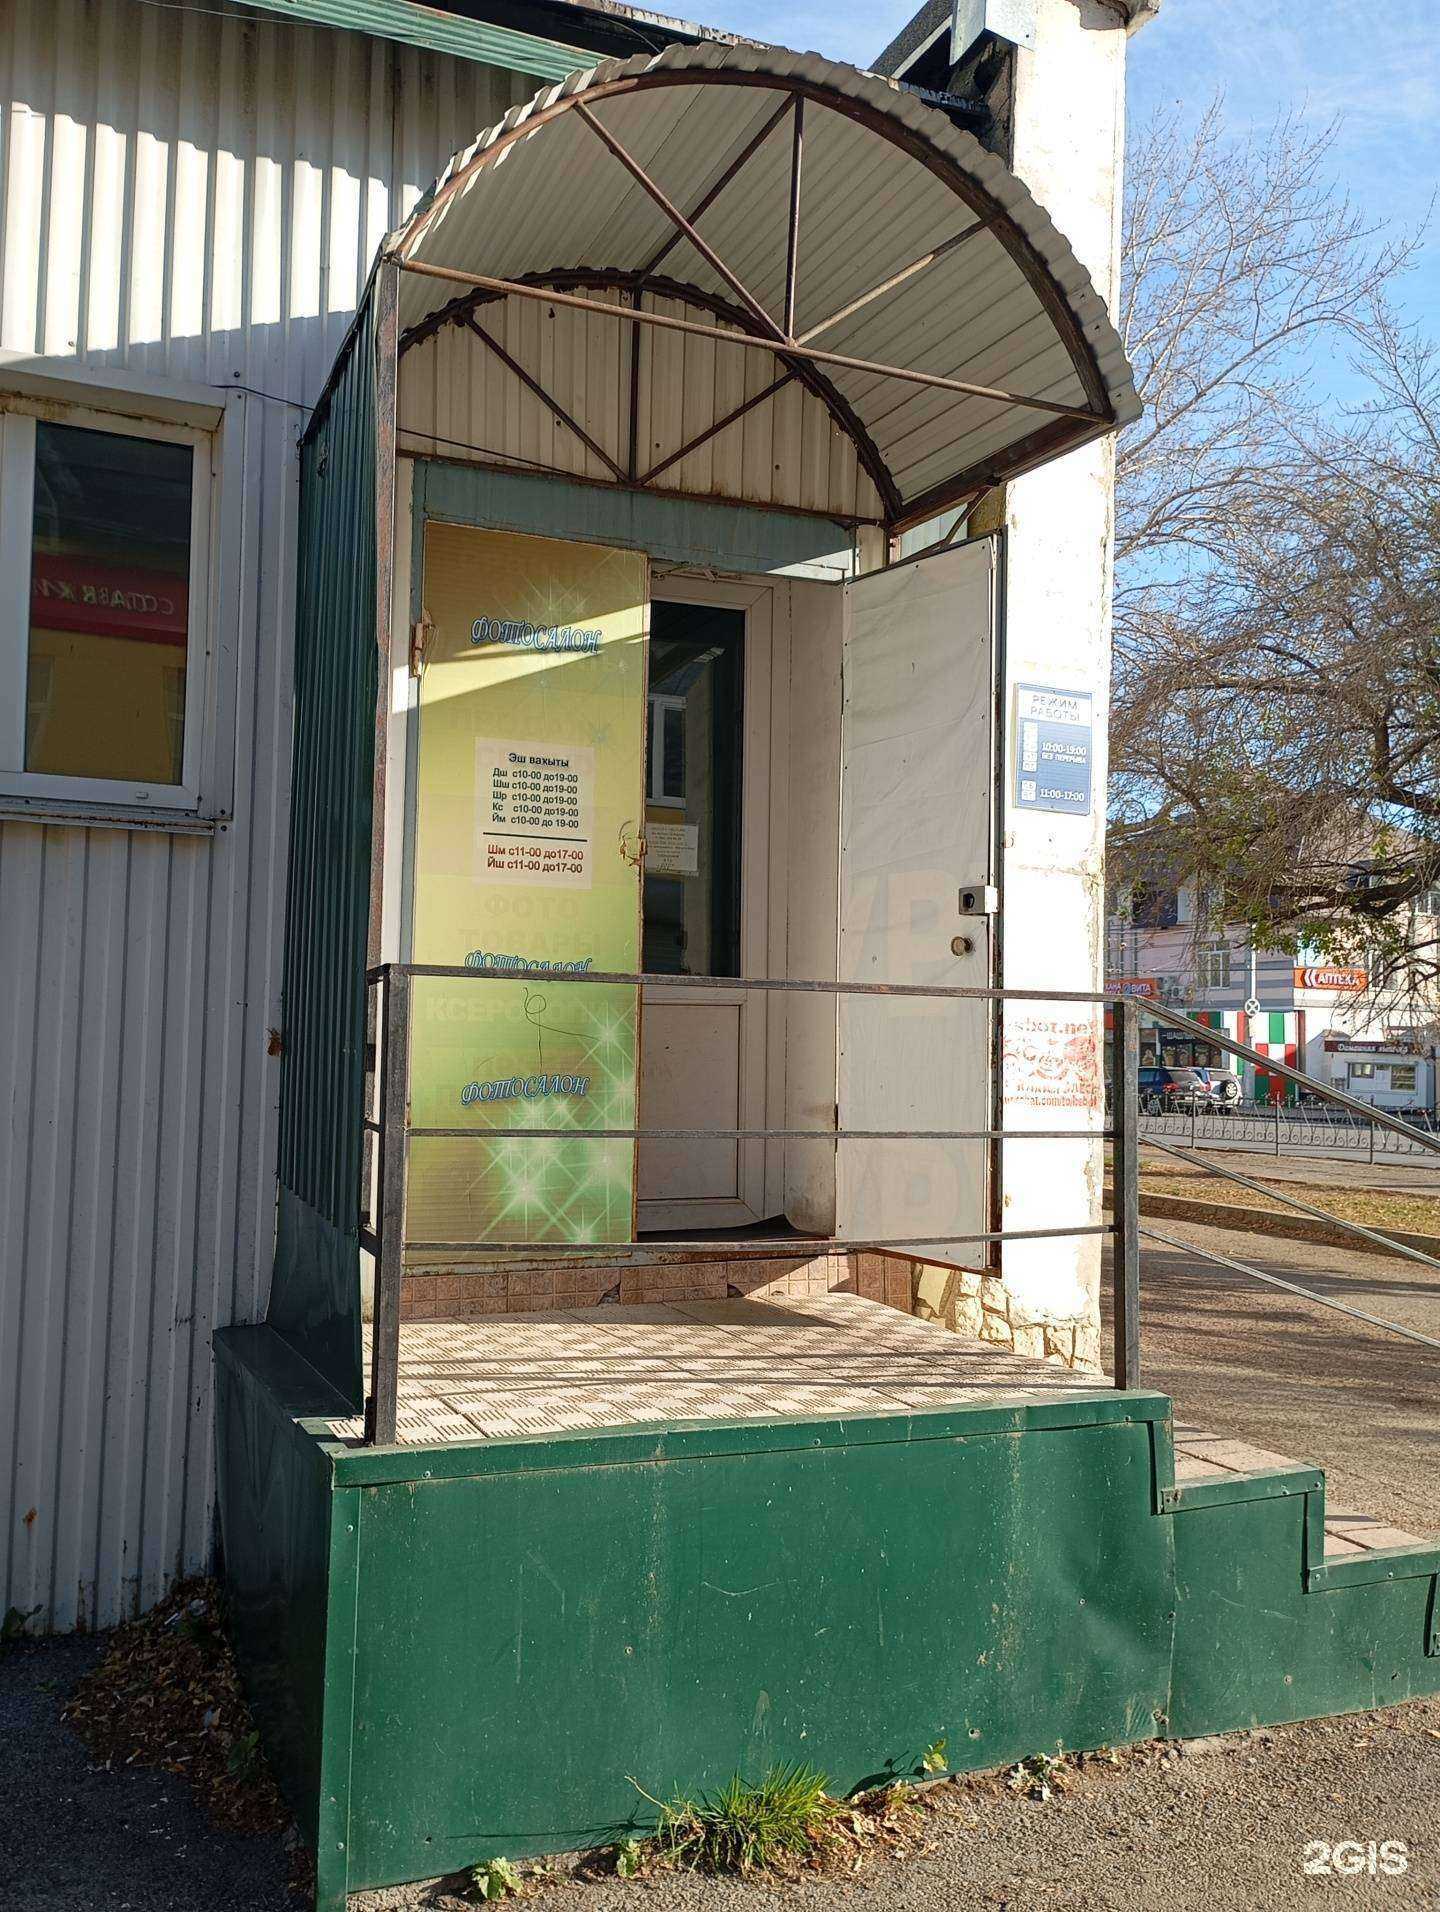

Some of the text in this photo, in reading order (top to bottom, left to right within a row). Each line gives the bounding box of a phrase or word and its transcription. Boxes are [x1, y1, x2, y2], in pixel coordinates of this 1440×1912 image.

[1032, 694, 1077, 710] РЕЖИМ
[1030, 705, 1080, 721] РАБОТЫ
[508, 752, 526, 764] Эш
[493, 767, 508, 778] Дш
[512, 770, 542, 780] с10-00
[493, 779, 510, 789] Шш
[512, 781, 541, 792] с10-00
[493, 790, 507, 802] Шр
[512, 793, 541, 803] с10-00
[492, 802, 504, 812] Кс
[513, 804, 542, 815] с10-00
[492, 812, 506, 823] Йм
[511, 815, 540, 826] с10-00
[556, 819, 579, 829] 19-00
[487, 844, 506, 856] Шм
[508, 846, 541, 859] с11-00
[487, 857, 505, 869] Йш
[507, 860, 540, 872] с11-00
[1318, 972, 1362, 986] АПТЕКА
[461, 1073, 591, 1106] ФОТОСАЛОН
